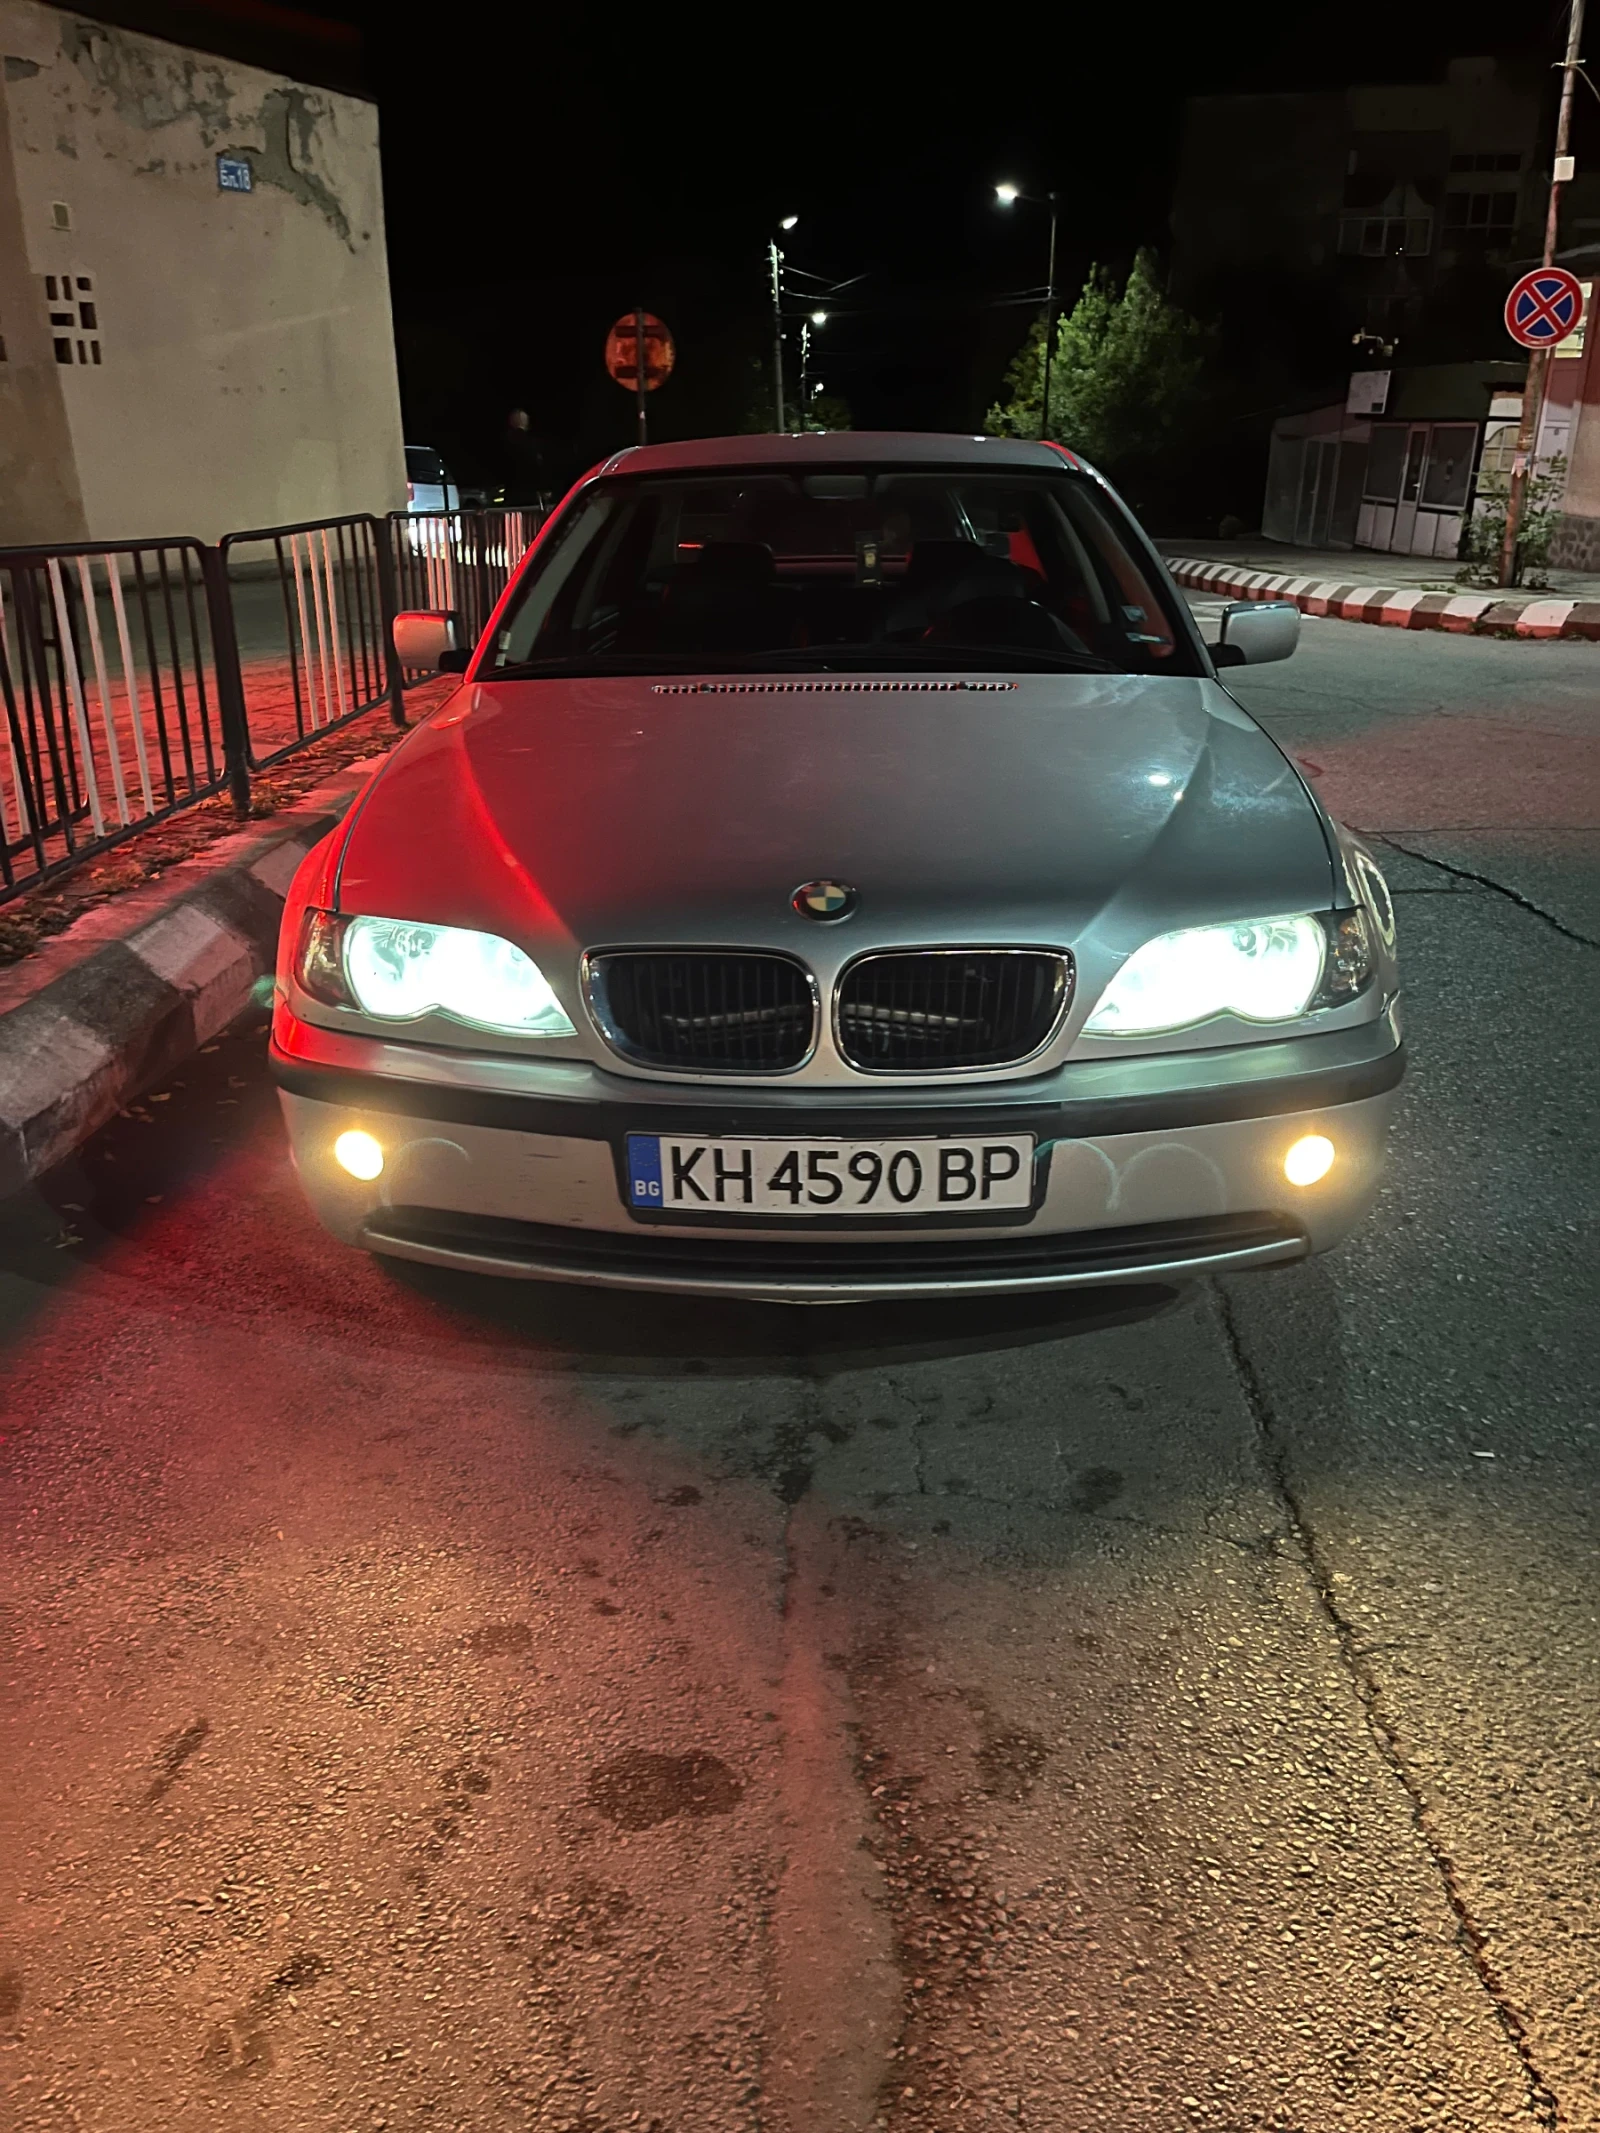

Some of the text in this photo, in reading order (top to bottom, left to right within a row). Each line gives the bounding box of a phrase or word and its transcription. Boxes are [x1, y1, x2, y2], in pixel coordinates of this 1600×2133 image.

[634, 1179, 660, 1196] BG
[671, 1145, 1020, 1205] KH 4590 BP
